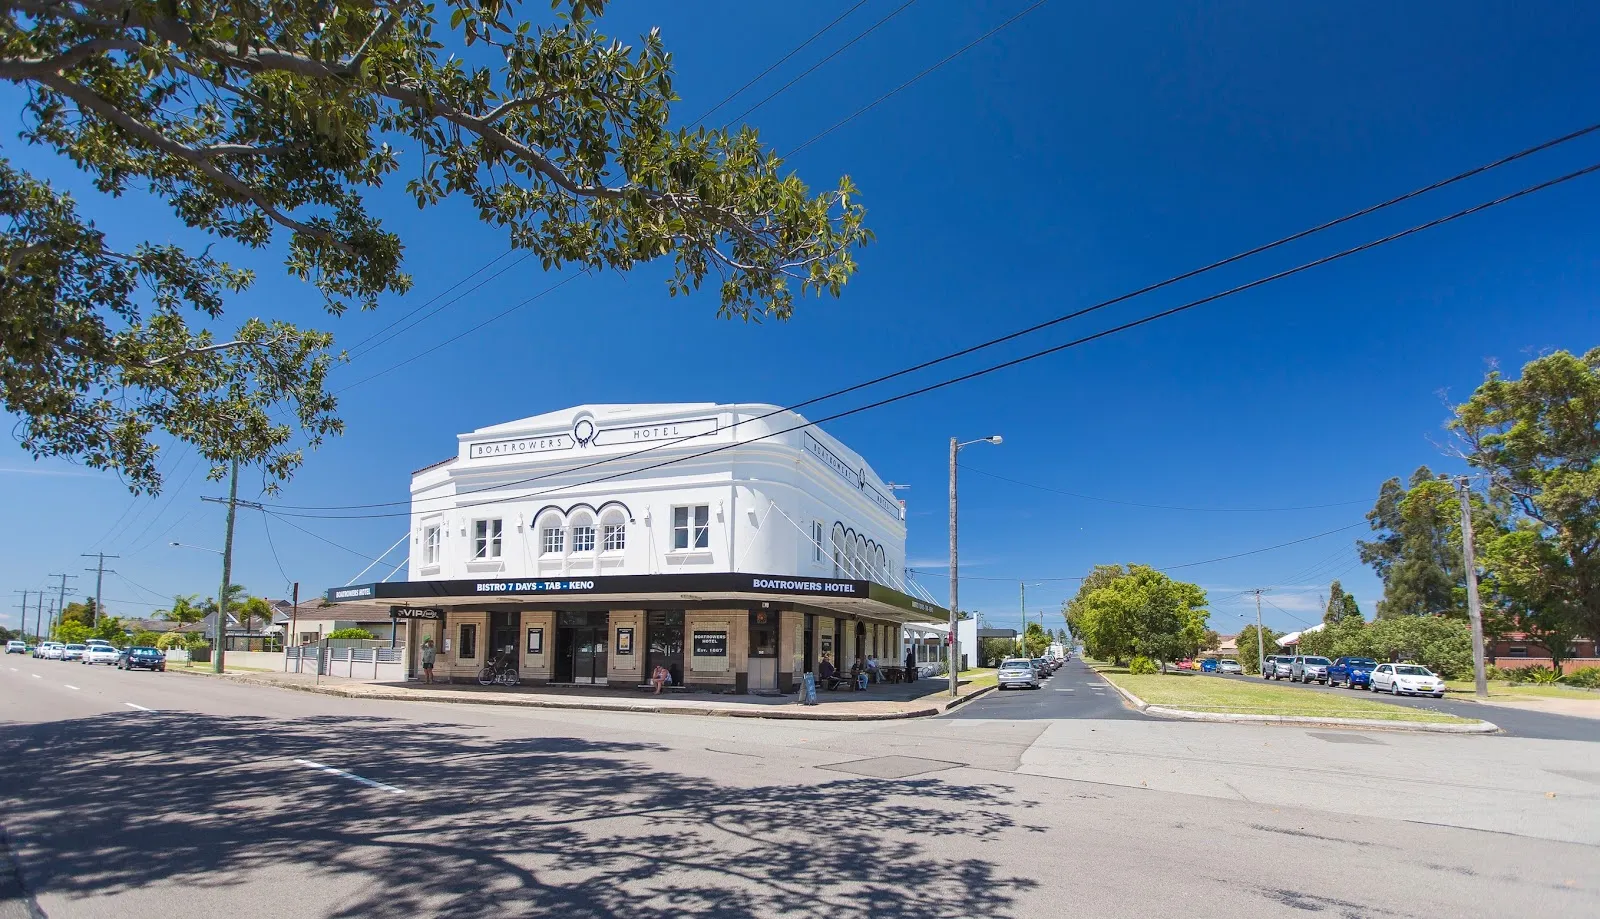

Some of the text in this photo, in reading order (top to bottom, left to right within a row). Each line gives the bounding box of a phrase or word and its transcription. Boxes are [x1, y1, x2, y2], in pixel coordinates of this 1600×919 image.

[478, 426, 679, 455] BOATROWERS HOTEL
[813, 443, 851, 479] BOATROWERS
[476, 583, 507, 592] BISTRO
[508, 583, 514, 591] 7
[515, 582, 537, 591] DAYS
[544, 581, 561, 590] TAB
[569, 580, 595, 590] KENO
[753, 578, 855, 593] BOATROWERS HOTEL
[403, 608, 423, 617] VIP
